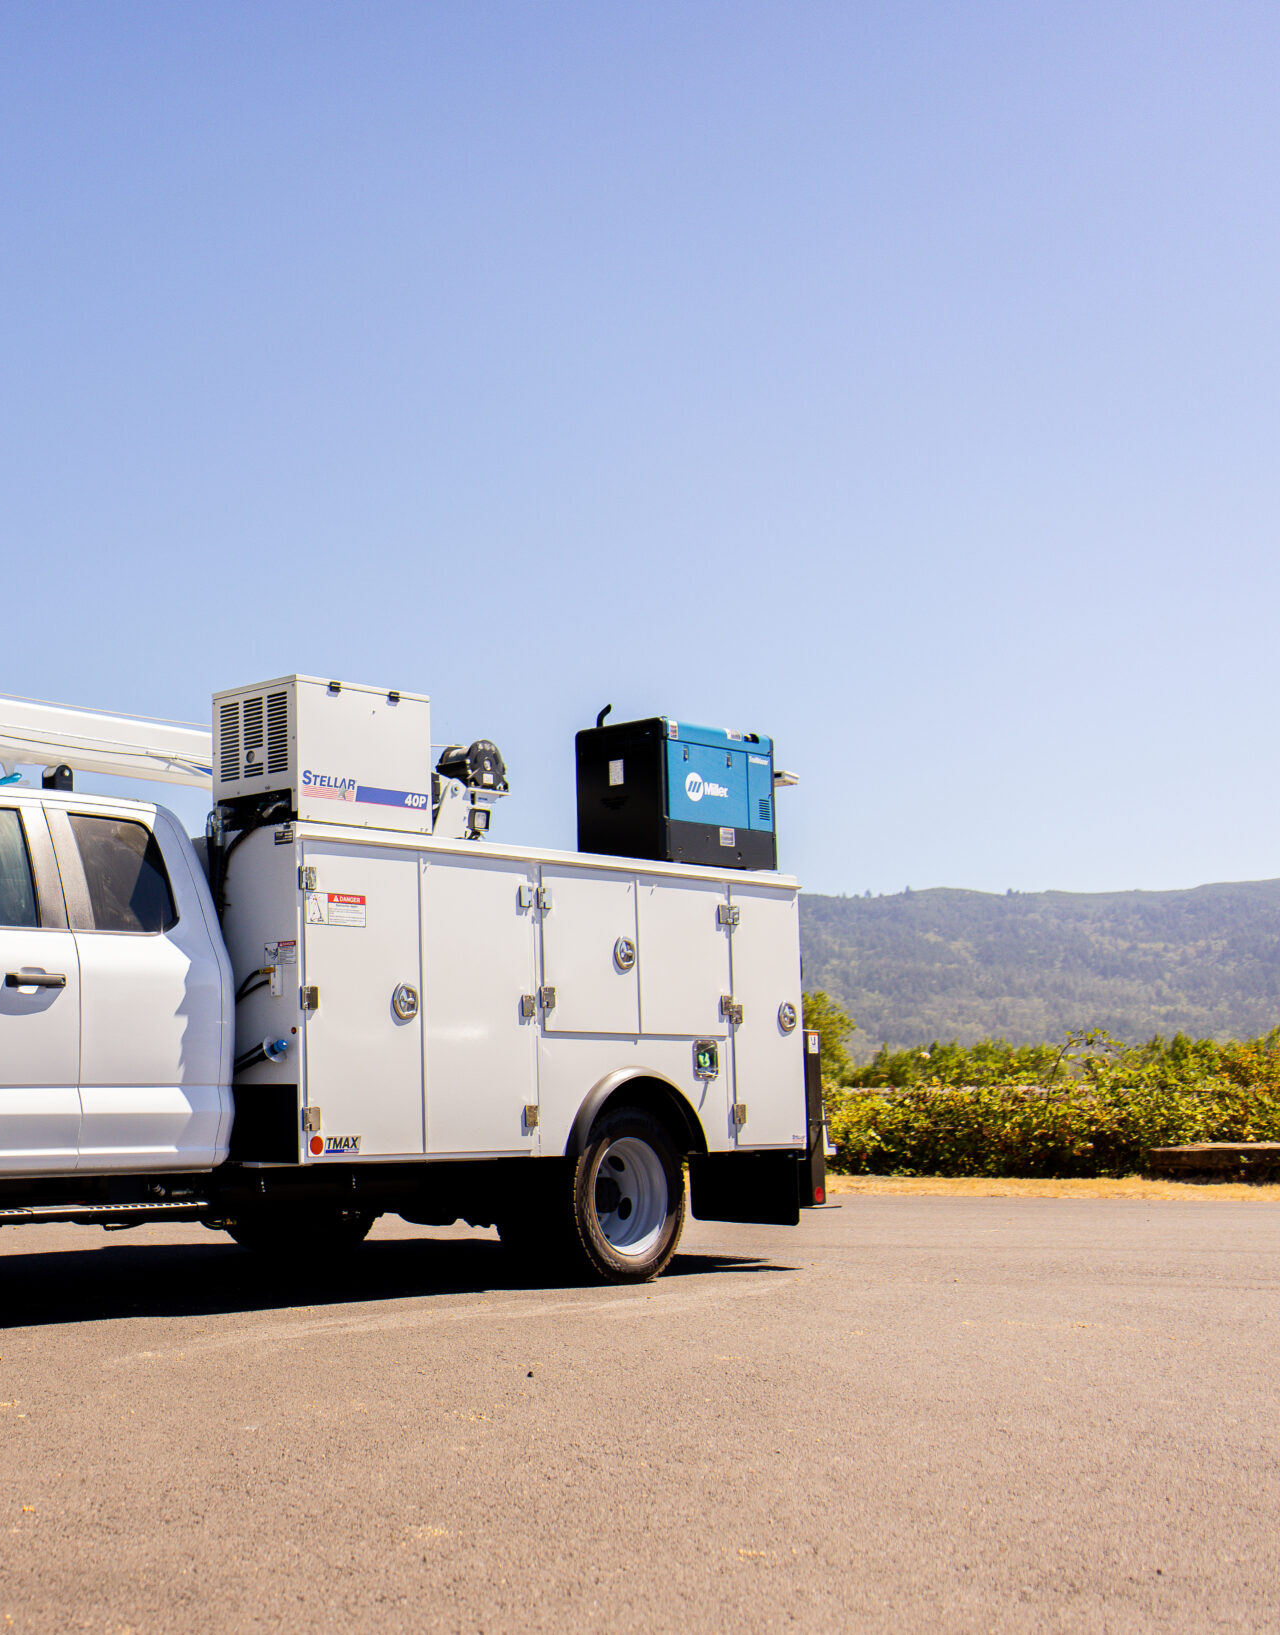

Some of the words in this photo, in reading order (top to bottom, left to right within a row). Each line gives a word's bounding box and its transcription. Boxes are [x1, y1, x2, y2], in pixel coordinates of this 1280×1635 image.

[302, 769, 356, 790] STELLAR
[704, 781, 729, 798] Miller
[404, 794, 427, 808] 40P
[339, 895, 361, 904] DANGER
[327, 1136, 359, 1149] TMAX
